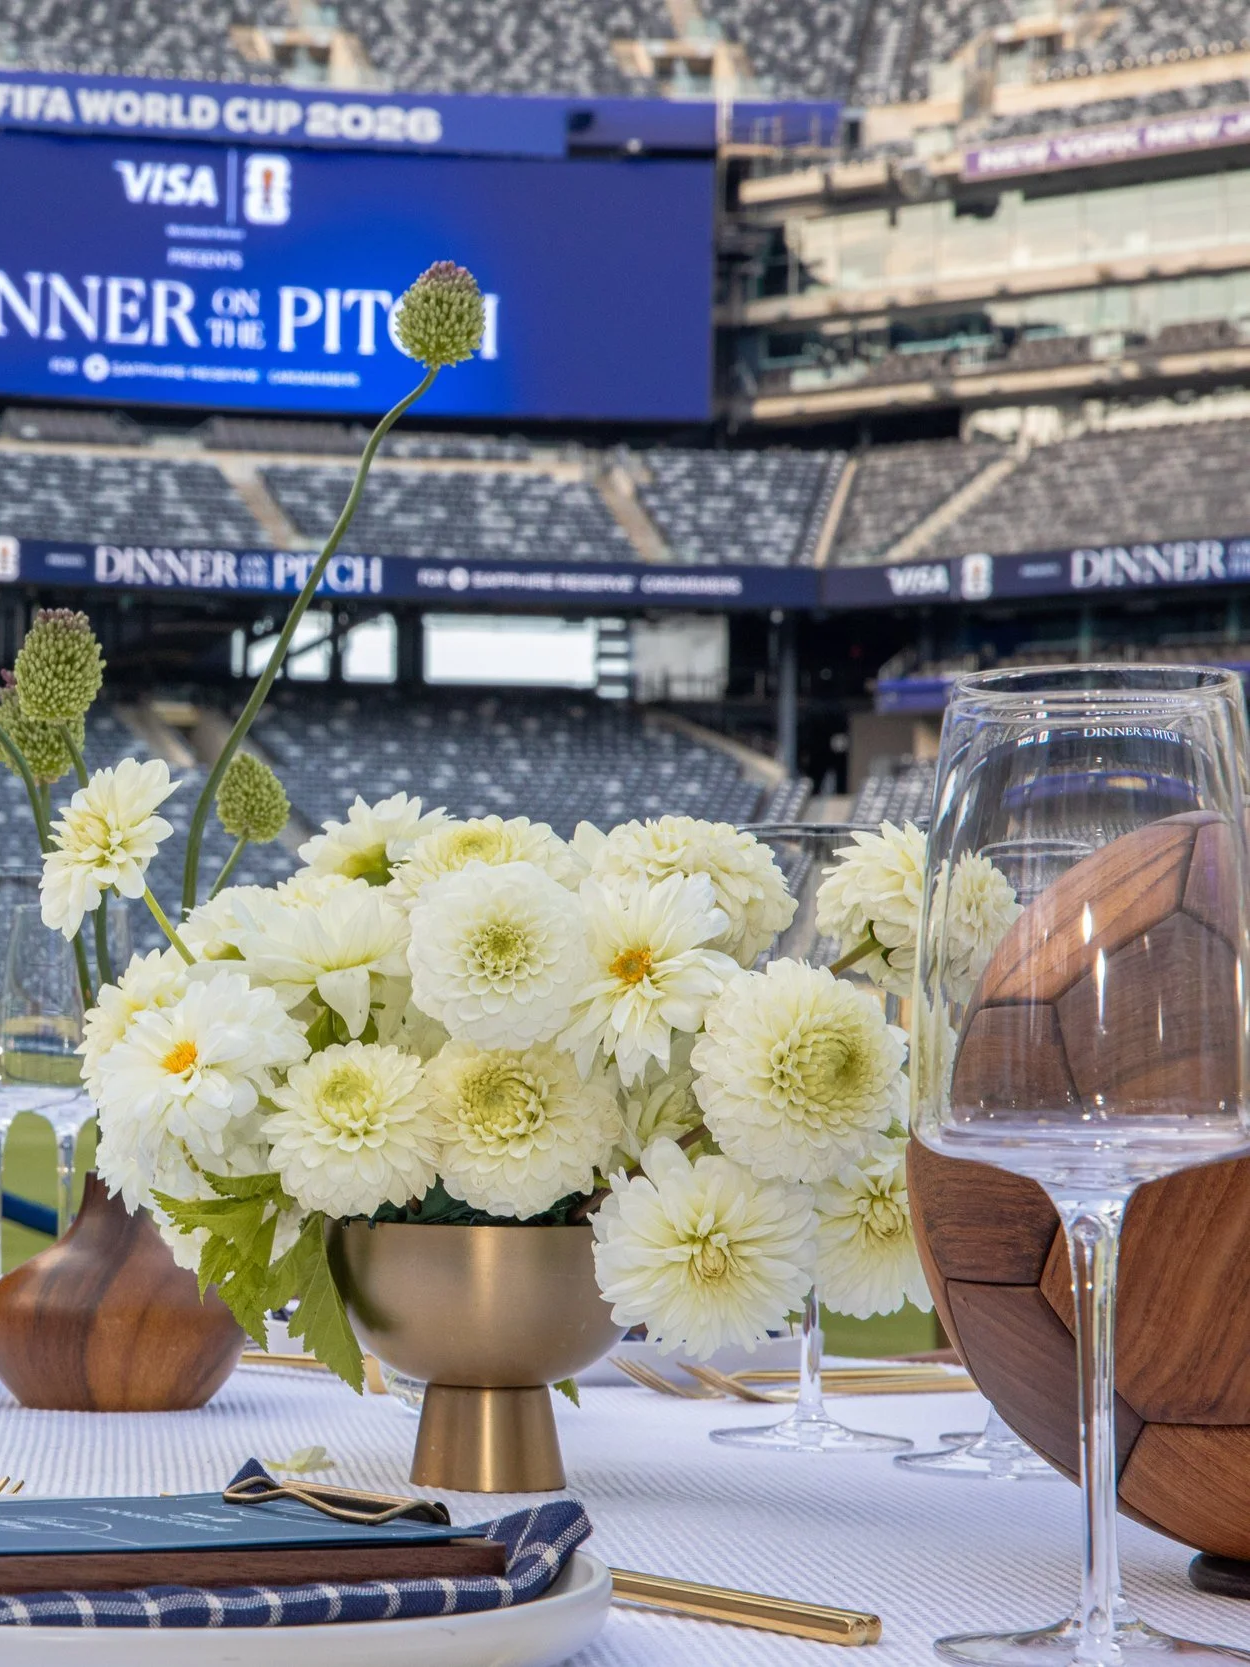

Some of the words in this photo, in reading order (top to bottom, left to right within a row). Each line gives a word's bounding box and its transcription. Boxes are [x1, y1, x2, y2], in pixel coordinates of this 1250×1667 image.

[76, 88, 220, 130] WORLD
[222, 96, 303, 135] CUP
[304, 101, 443, 144] 2026
[112, 160, 219, 207] VISA
[211, 286, 260, 317] ON
[205, 318, 266, 349] THE
[278, 285, 499, 360] PIT
[95, 545, 238, 589] DINNER
[885, 564, 949, 597] VISA
[1071, 540, 1226, 588] DINNER
[1017, 735, 1034, 748] VISA
[1084, 726, 1142, 738] DINNER
[1152, 727, 1180, 744] PITCH
